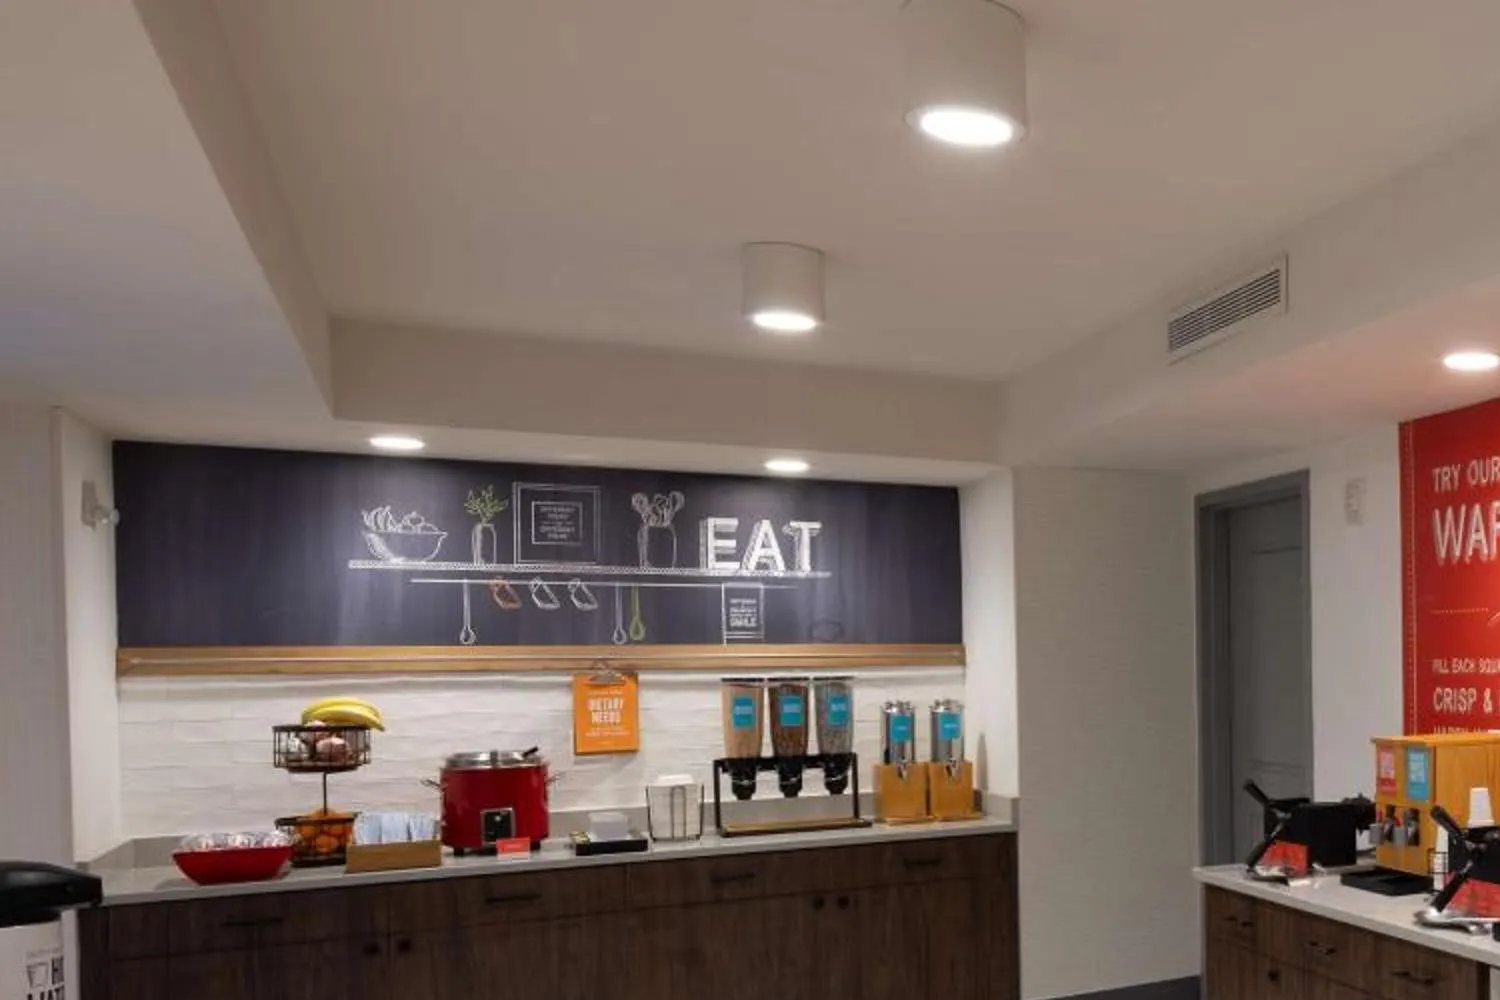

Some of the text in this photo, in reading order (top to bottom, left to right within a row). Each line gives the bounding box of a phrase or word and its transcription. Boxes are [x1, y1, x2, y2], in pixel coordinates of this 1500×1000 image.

[1432, 464, 1461, 493] TRY
[699, 517, 823, 575] EAT
[1452, 657, 1475, 674] EACH
[1433, 686, 1477, 714] CRISP
[1483, 687, 1493, 714] &
